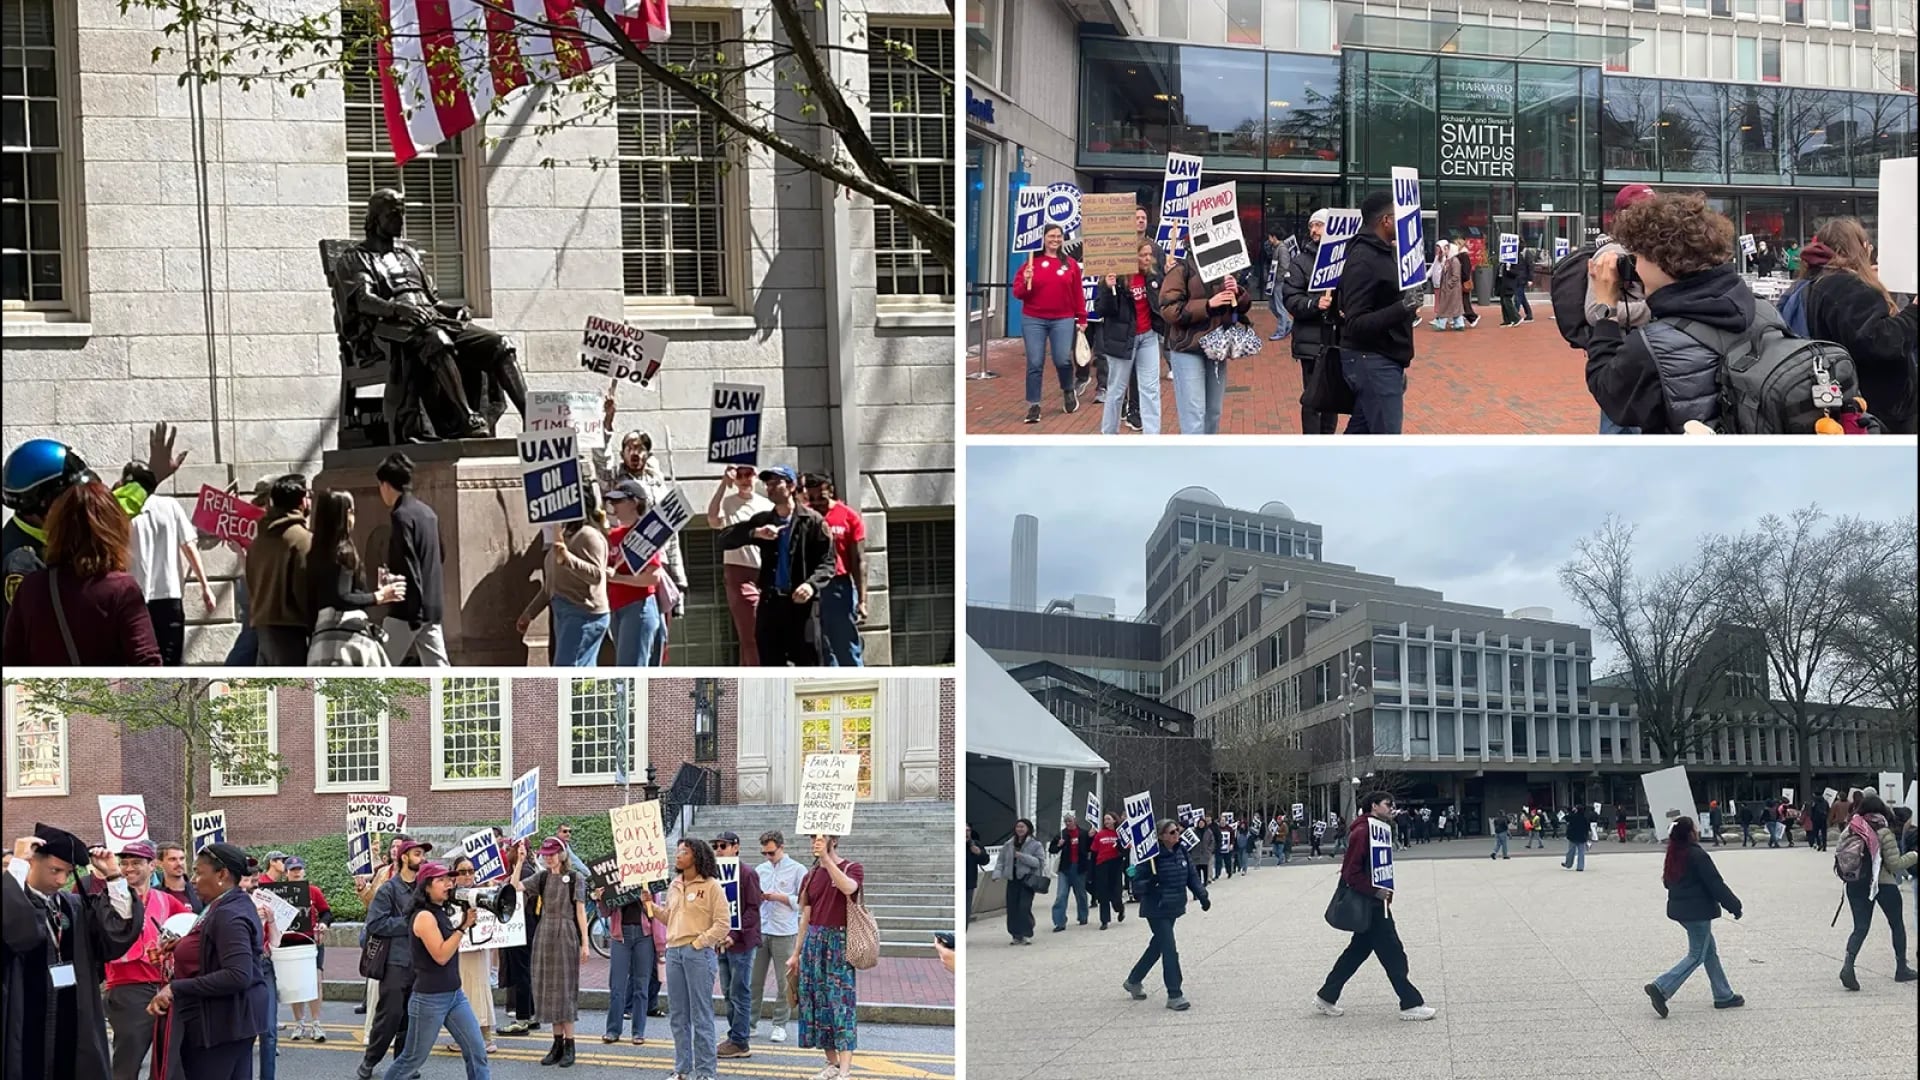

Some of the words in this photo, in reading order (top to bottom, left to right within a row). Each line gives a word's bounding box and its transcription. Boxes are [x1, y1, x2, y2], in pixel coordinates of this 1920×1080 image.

[1456, 81, 1513, 94] HARVARD
[1441, 123, 1514, 145] SMITH
[1441, 144, 1514, 161] CAMPUS
[1169, 159, 1200, 177] UAW
[1441, 160, 1514, 177] CENTER
[1175, 181, 1189, 197] ON
[1395, 178, 1419, 206] UAW
[1021, 192, 1045, 208] UAW
[1050, 201, 1070, 216] UAW
[1191, 190, 1233, 217] HARVARD
[1027, 213, 1038, 230] ON
[1192, 219, 1208, 234] PAY
[1326, 216, 1361, 236] UAW
[1502, 235, 1518, 243] UAW
[1330, 242, 1346, 263] ON
[1202, 254, 1246, 278] WORKERS
[586, 316, 644, 341] HARVARD
[583, 330, 644, 362] WORKS
[581, 353, 612, 374] WE
[616, 360, 660, 387] DO!
[714, 389, 762, 412] UAW
[726, 418, 744, 438] ON
[521, 437, 572, 463] UAW
[711, 434, 757, 459] STRIKE
[541, 467, 562, 493] ON
[203, 490, 238, 514] REAL
[530, 482, 580, 520] STRIKE
[660, 490, 688, 528] UAW
[216, 513, 258, 541] RECO
[643, 520, 663, 540] ON
[623, 531, 657, 561] STRIKE
[810, 756, 829, 767] FAIR
[830, 756, 846, 768] PAY
[808, 770, 840, 779] COLA
[513, 773, 537, 798] UAW
[804, 782, 856, 791] PROTECTION
[349, 796, 390, 805] HARVARD
[804, 792, 840, 801] AGAINST
[804, 801, 852, 810] HARASSMENT
[612, 803, 657, 827] (STILL)
[804, 812, 819, 820] ICE
[820, 813, 841, 822] OFF
[1128, 796, 1151, 818] UAW
[111, 814, 141, 829] ICE
[194, 815, 222, 831] UAW
[1140, 819, 1150, 839] ON
[465, 833, 493, 853] UAW
[615, 821, 660, 845] can't
[1371, 823, 1390, 845] UAW
[623, 842, 659, 860] eat
[1136, 830, 1158, 859] STRIKE
[478, 851, 491, 865] ON
[592, 859, 617, 876] WH
[475, 857, 502, 883] STRIKE
[620, 859, 667, 882] prestige
